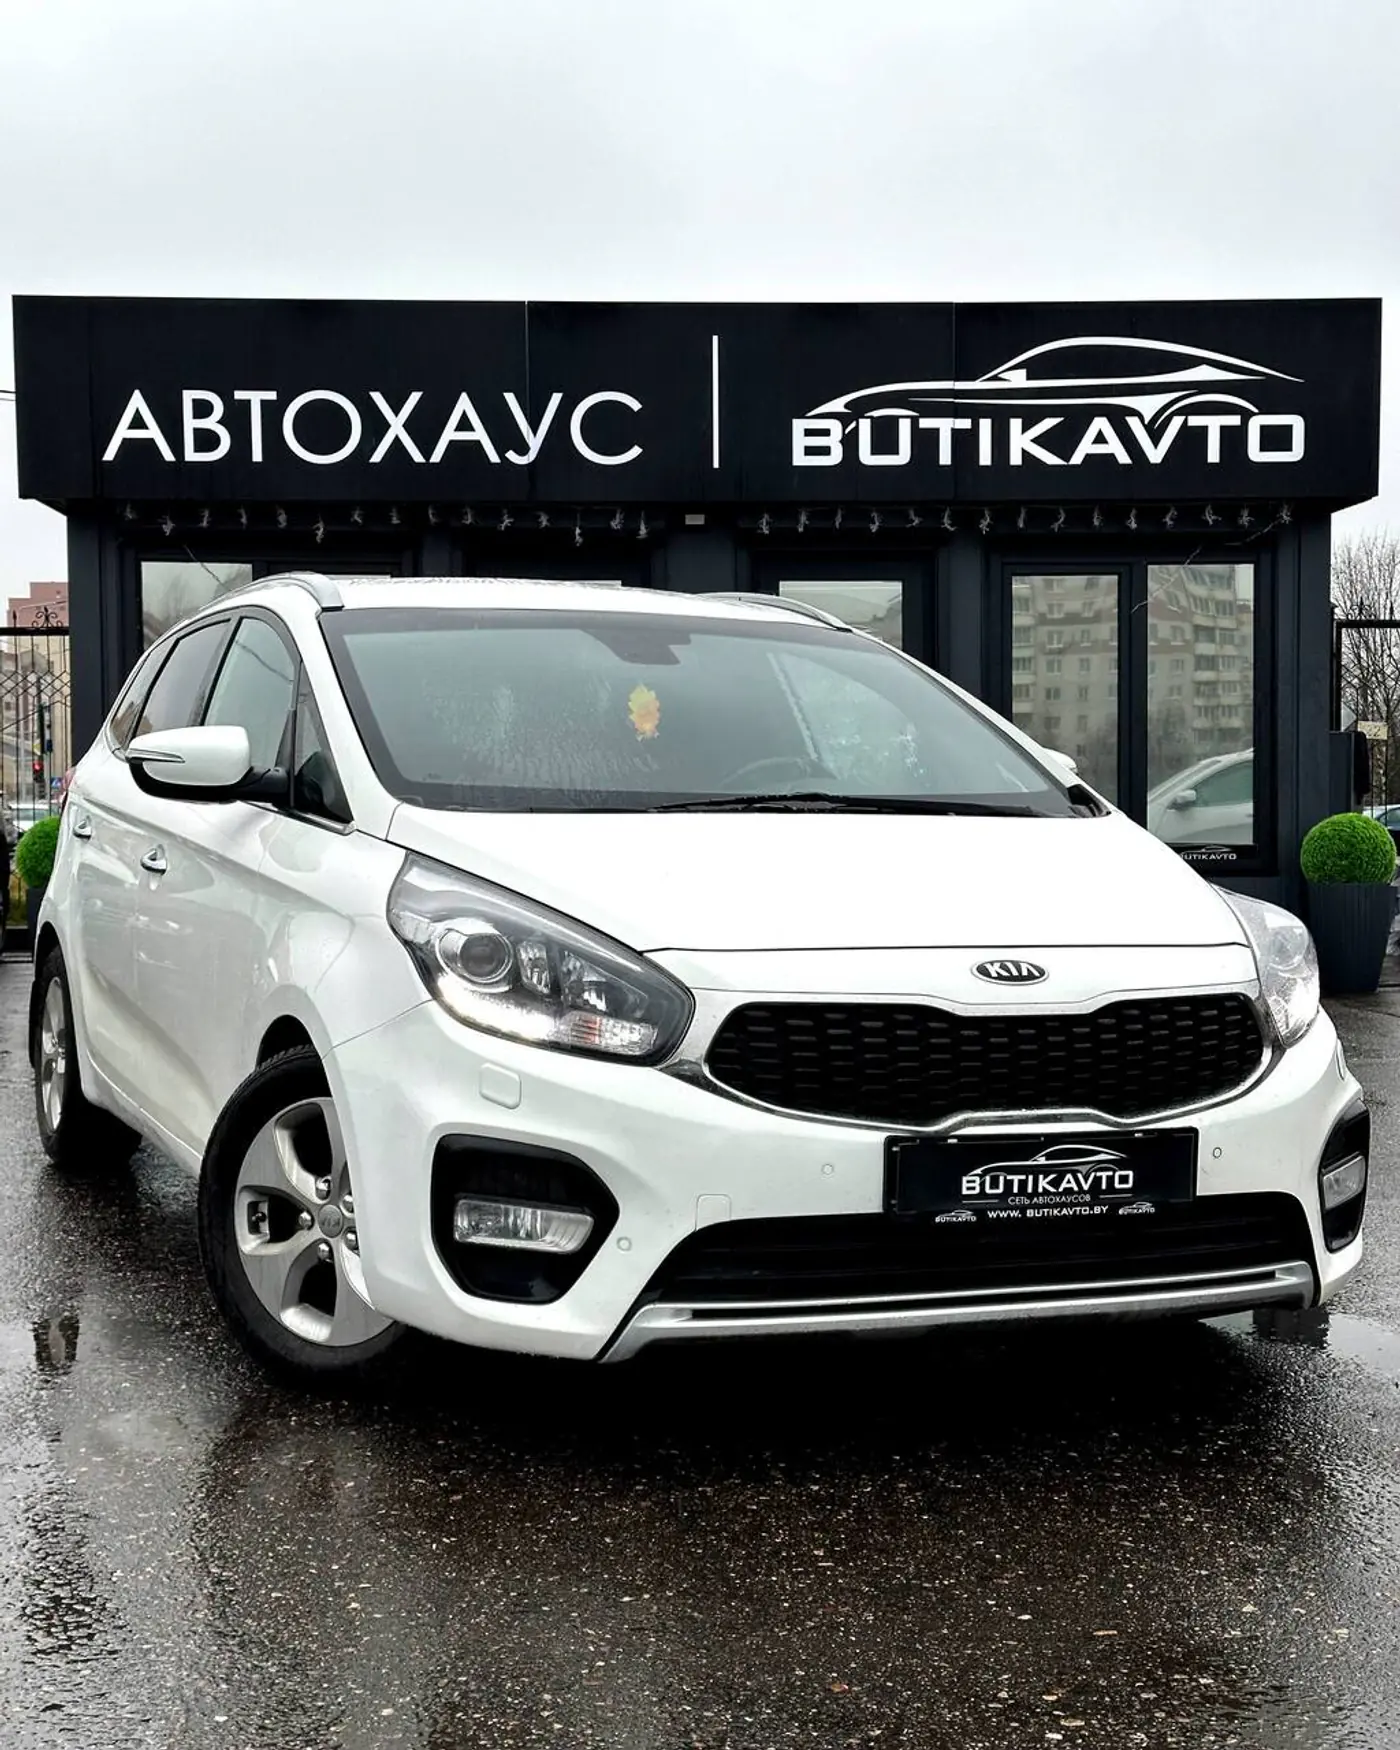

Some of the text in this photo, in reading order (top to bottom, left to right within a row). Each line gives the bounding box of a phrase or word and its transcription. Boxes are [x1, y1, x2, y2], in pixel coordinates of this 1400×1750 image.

[101, 389, 644, 465] АВТОХАУС
[791, 412, 1306, 467] BUTIKAVTO
[983, 961, 1041, 977] KIA
[961, 1170, 1134, 1195] BUTIKAVTO
[1007, 1194, 1091, 1206] СЕТЬ АВТОХАУСОВ
